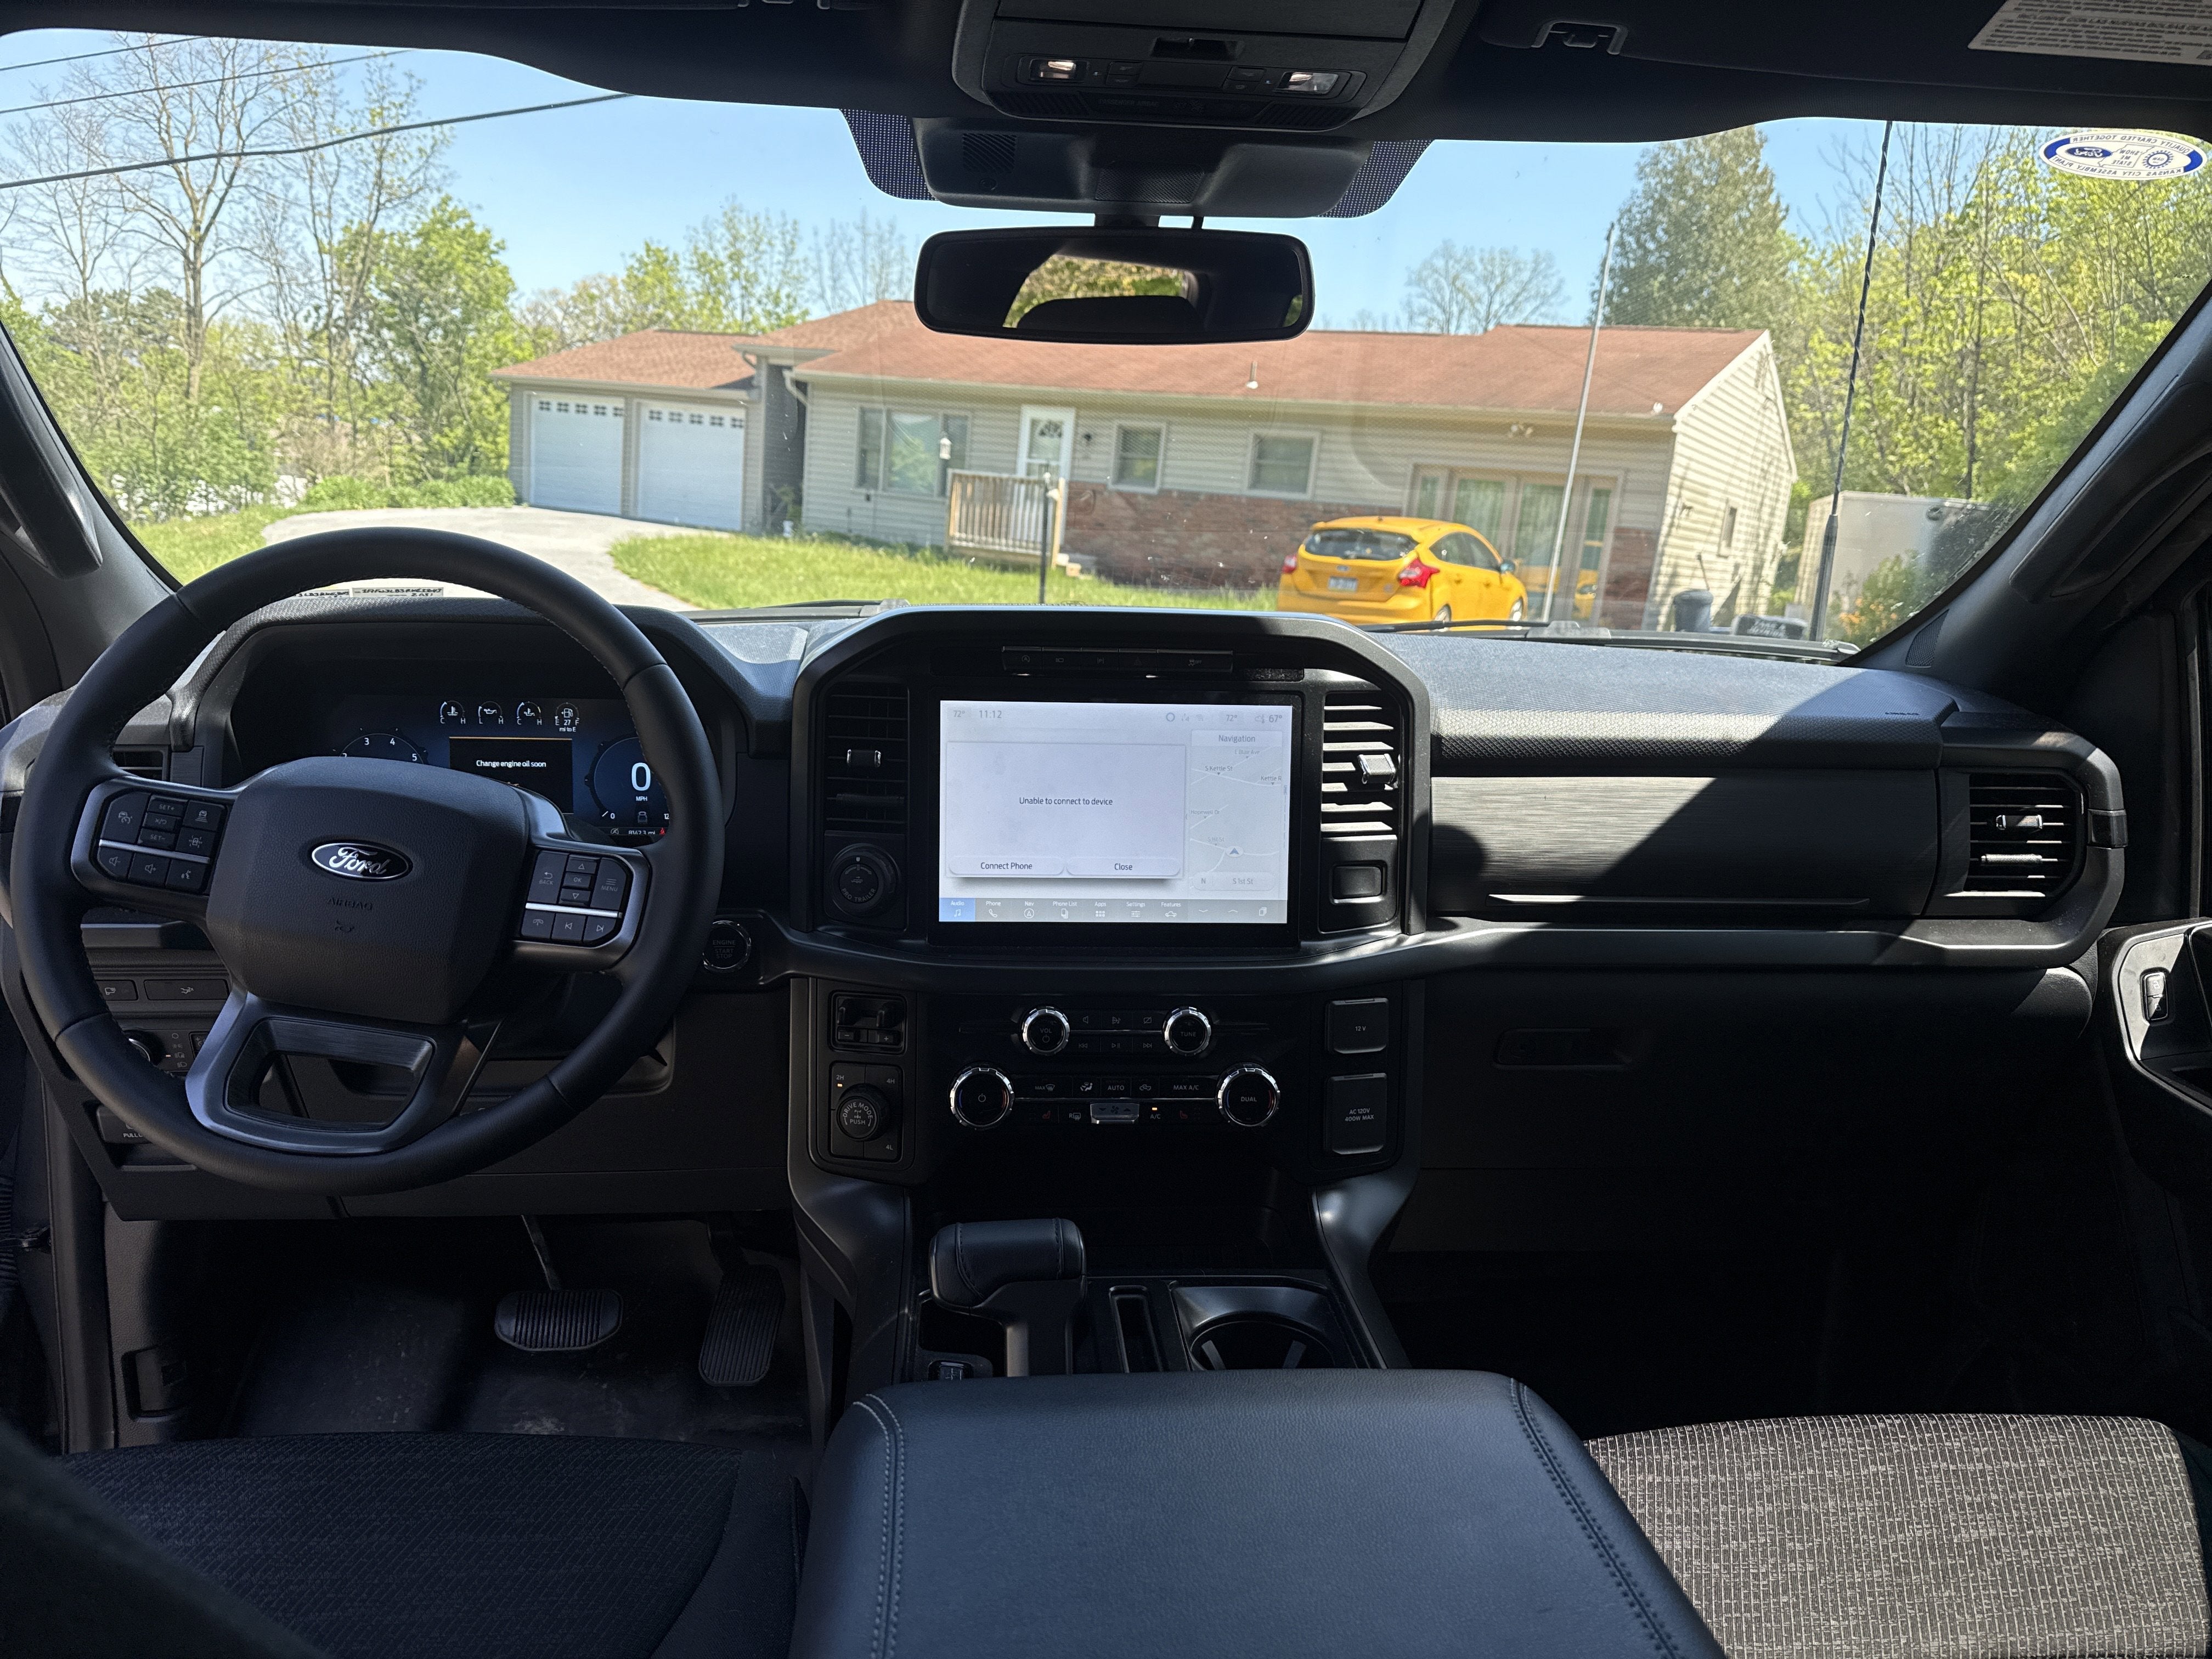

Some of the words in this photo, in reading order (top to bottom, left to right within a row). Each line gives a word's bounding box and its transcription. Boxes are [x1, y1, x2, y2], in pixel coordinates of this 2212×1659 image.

[979, 710, 1002, 719] 11:12
[364, 737, 369, 746] 3
[390, 737, 396, 746] 4
[1218, 735, 1256, 743] Navigation
[412, 753, 417, 761] 5
[476, 760, 500, 768] Change
[500, 760, 521, 768] engine
[631, 762, 651, 791] 0
[1019, 797, 1043, 805] Unable
[1054, 797, 1081, 805] connect
[1091, 797, 1113, 805] device
[329, 847, 391, 874] Ford
[840, 888, 853, 902] PRO
[854, 888, 877, 904] TRAILER
[328, 896, 374, 911] AIRBAG
[843, 1102, 857, 1118] DRIVE
[857, 1102, 873, 1119] MODE
